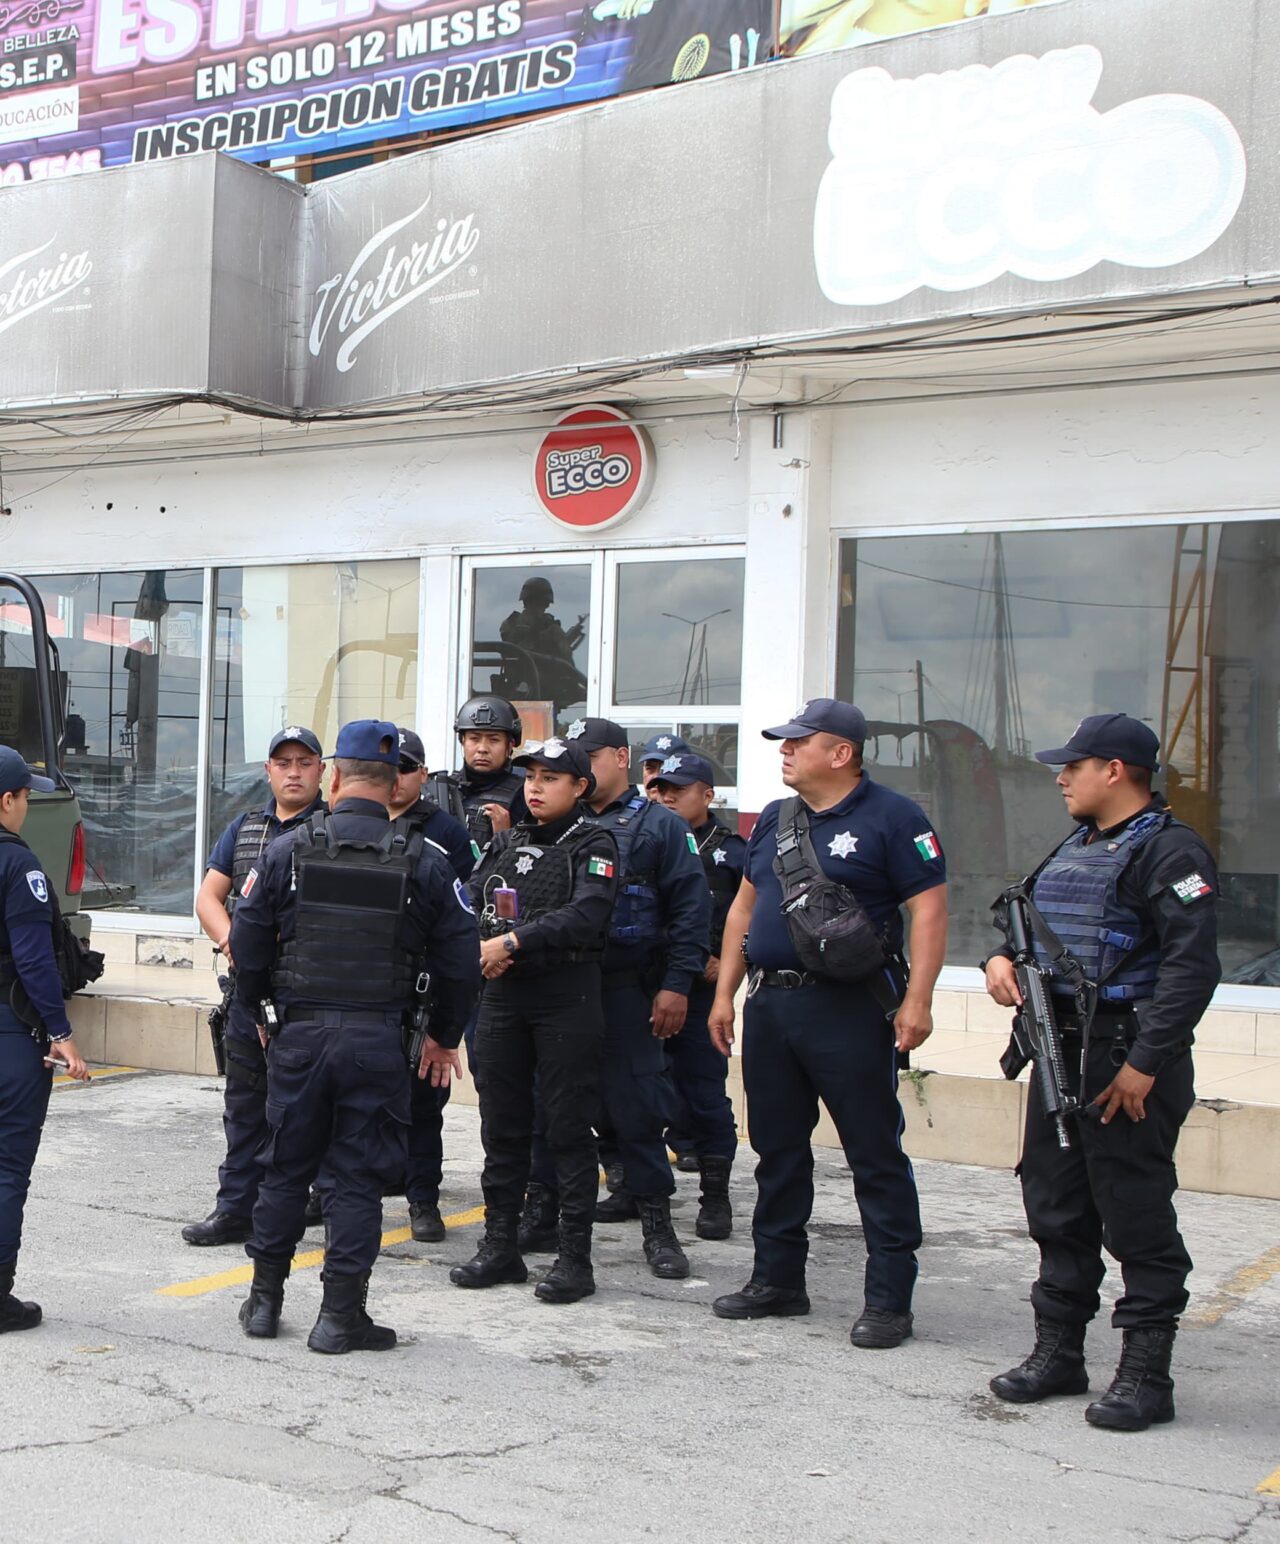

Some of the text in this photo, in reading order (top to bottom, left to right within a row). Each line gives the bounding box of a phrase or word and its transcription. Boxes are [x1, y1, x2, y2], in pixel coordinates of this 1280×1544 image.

[4, 25, 79, 53] BELLEZA
[196, 62, 236, 100] EN
[247, 42, 335, 90] SOLO
[345, 30, 386, 69] 12
[396, 5, 521, 60] MESES
[0, 53, 68, 88] S.E.P.
[133, 43, 575, 163] INSCRIPCION GRATIS
[309, 191, 480, 372] Victoria
[548, 447, 599, 467] Super
[549, 458, 628, 494] ECCO
